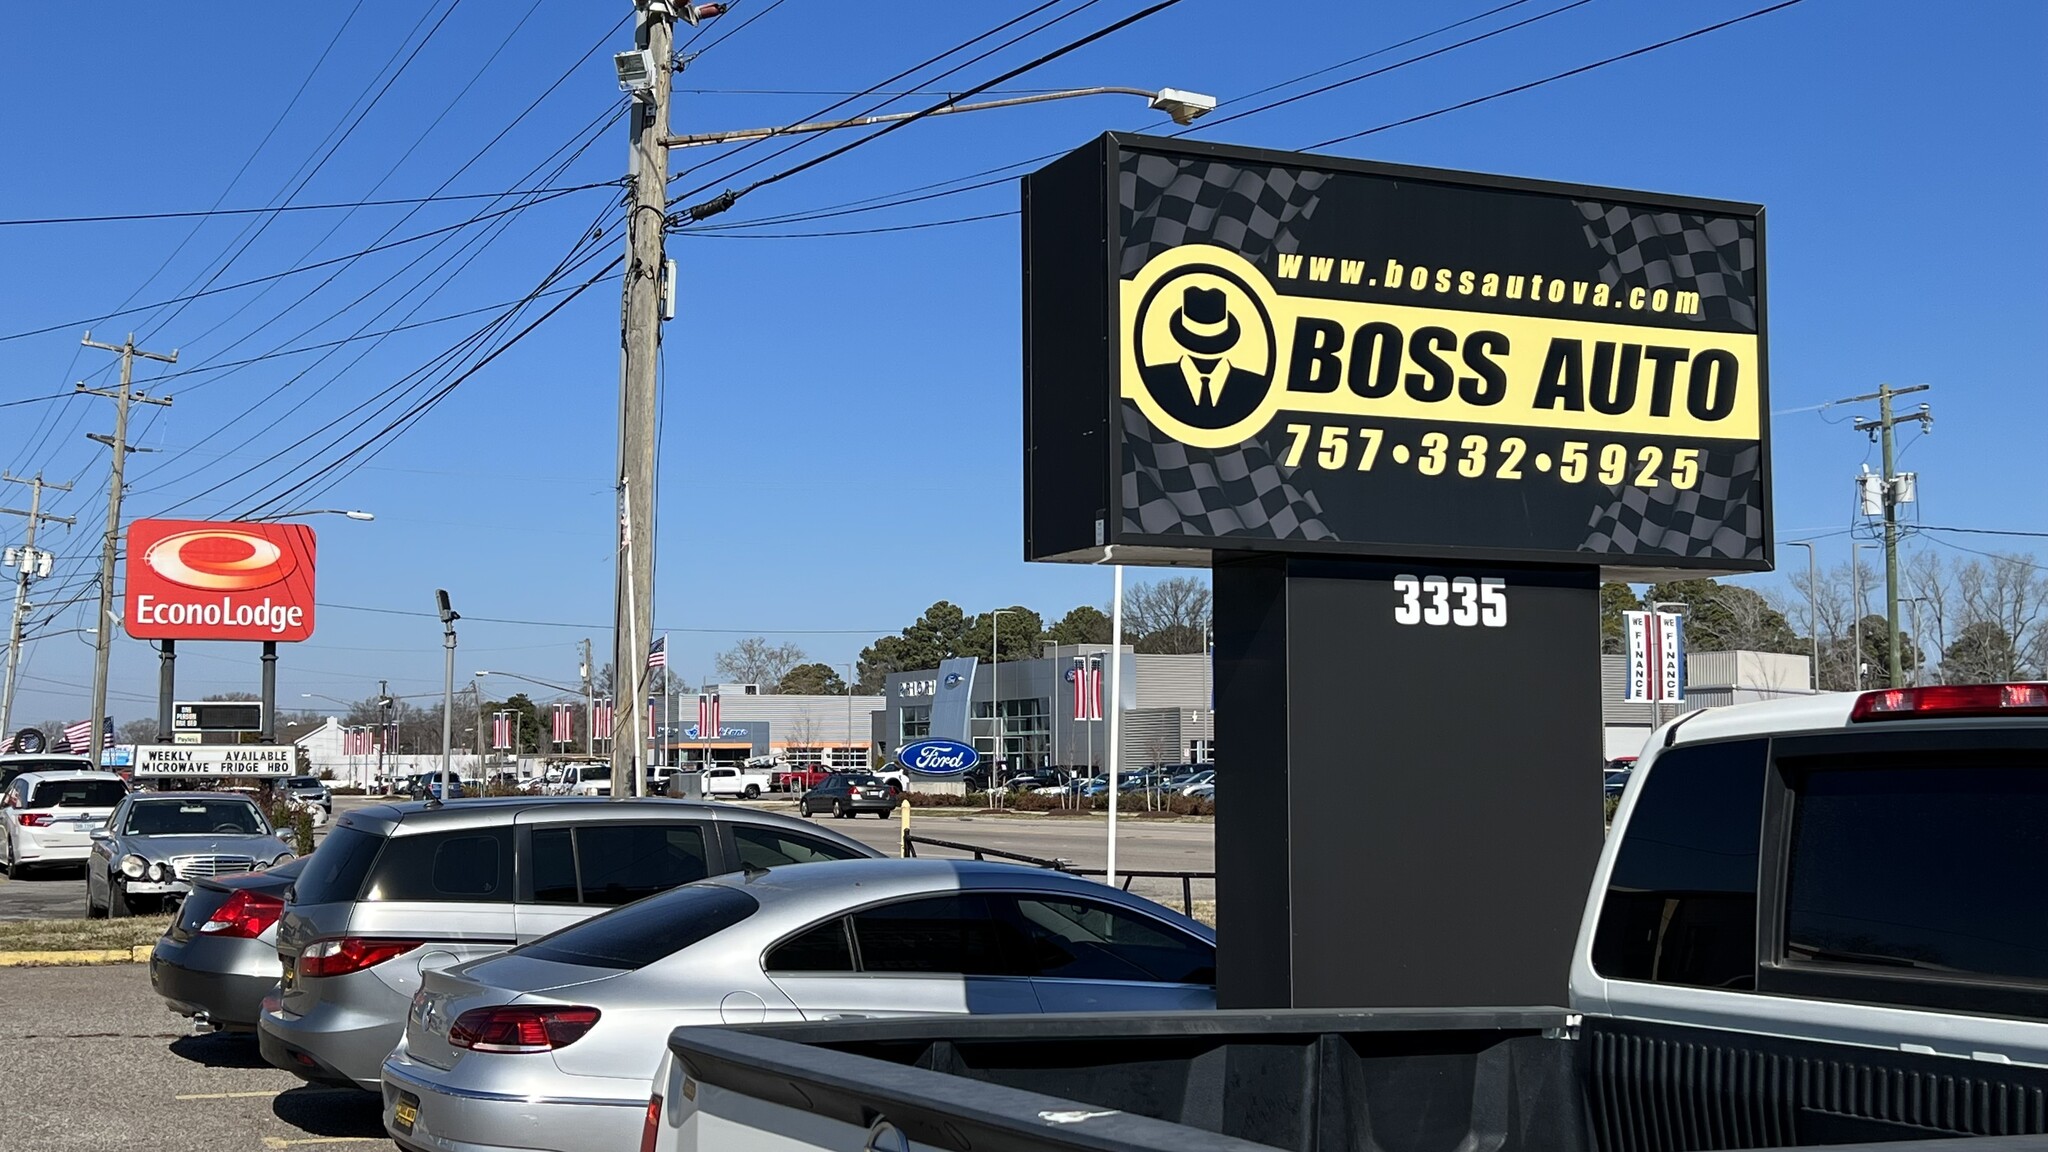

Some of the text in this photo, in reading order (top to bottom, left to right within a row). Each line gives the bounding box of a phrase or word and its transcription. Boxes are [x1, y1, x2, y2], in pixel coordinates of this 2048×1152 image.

[1277, 253, 1701, 316] www.bossautova.com
[1286, 316, 1740, 423] BOSS AUTO
[137, 594, 303, 633] EconoLodge
[1393, 575, 1508, 628] 3335
[1632, 617, 1644, 698] WE FINANCE
[1663, 618, 1676, 698] WE FINANCE
[141, 762, 289, 773] MICROWAVE FRIDGE HBO
[148, 751, 287, 761] WEEKLY AVAILABLE
[915, 746, 965, 768] Ford
